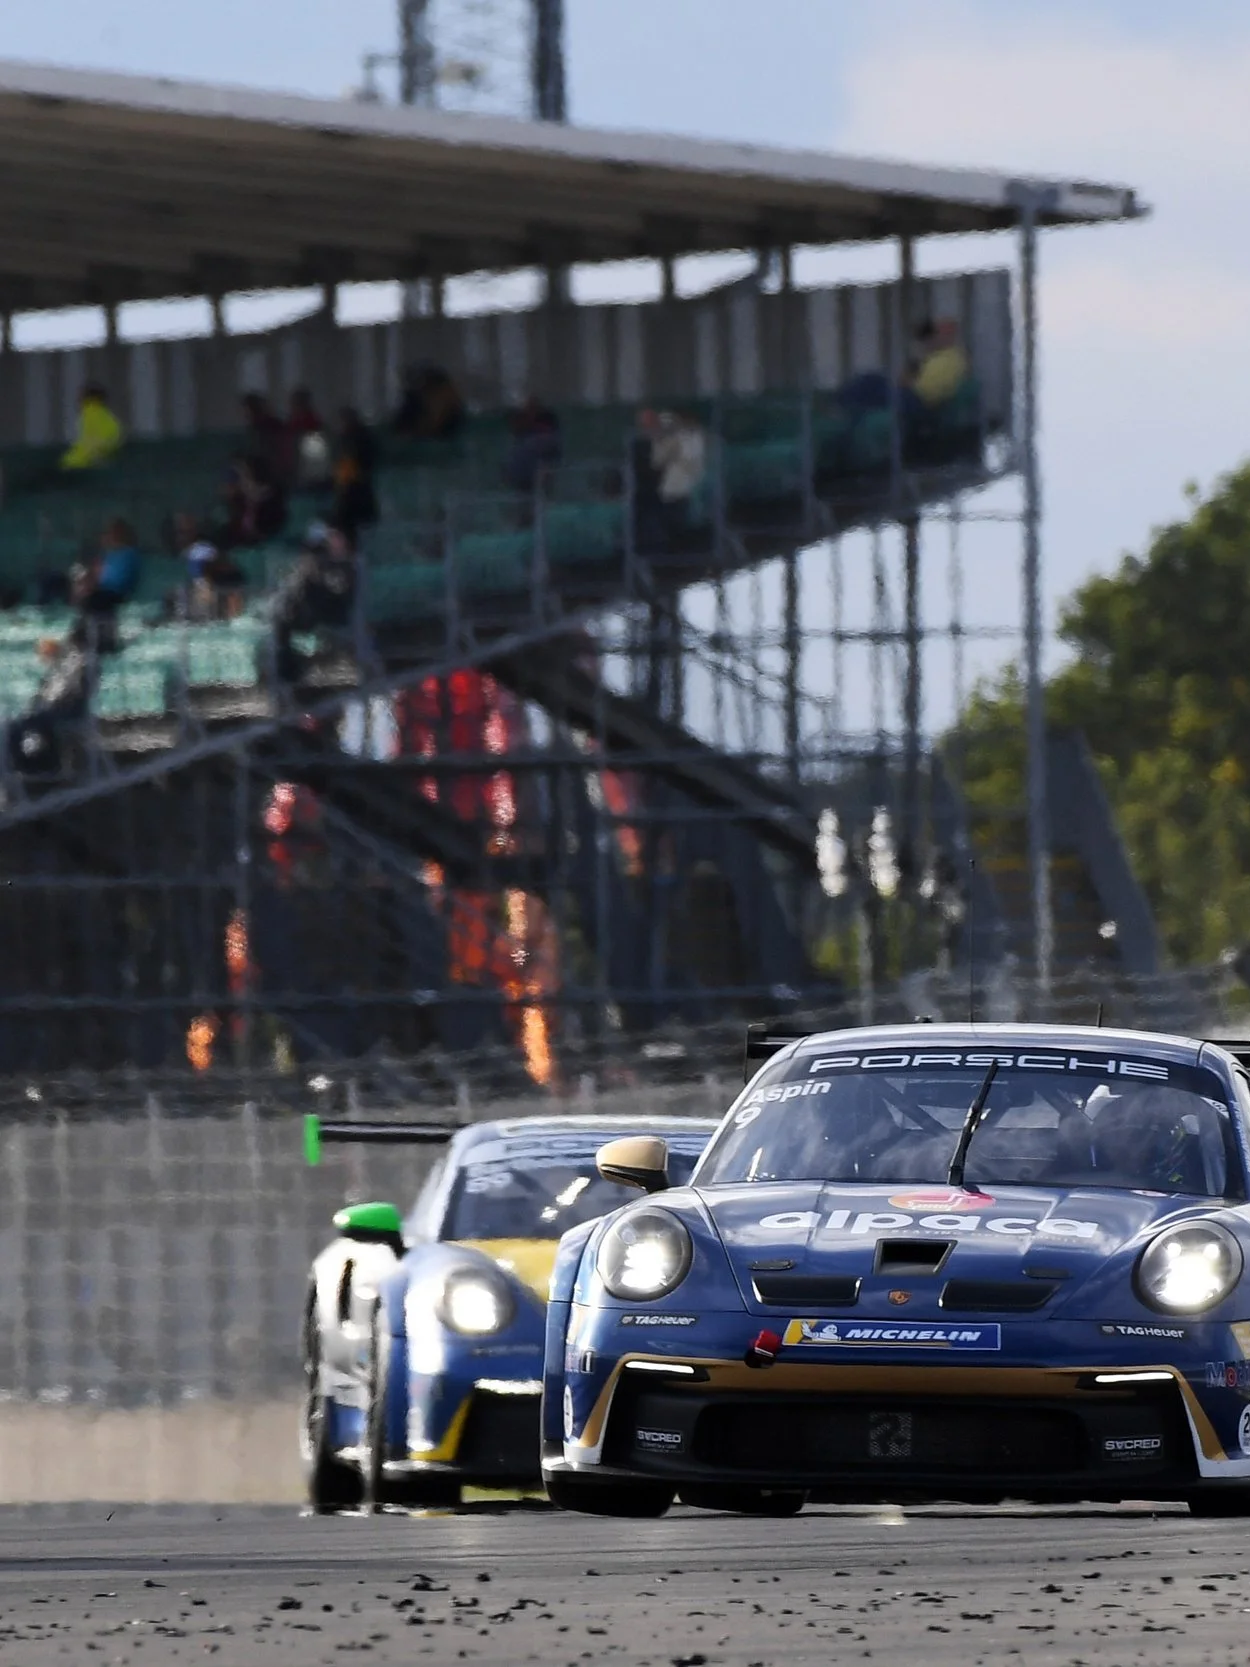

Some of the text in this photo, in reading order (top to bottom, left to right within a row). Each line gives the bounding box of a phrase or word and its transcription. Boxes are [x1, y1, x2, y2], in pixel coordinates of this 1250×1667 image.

[809, 1053, 1169, 1080] PORSCHE
[743, 1079, 832, 1107] Aspin
[735, 1106, 762, 1130] 9
[759, 1209, 1099, 1239] alpaca
[845, 1327, 982, 1344] MICHELIN
